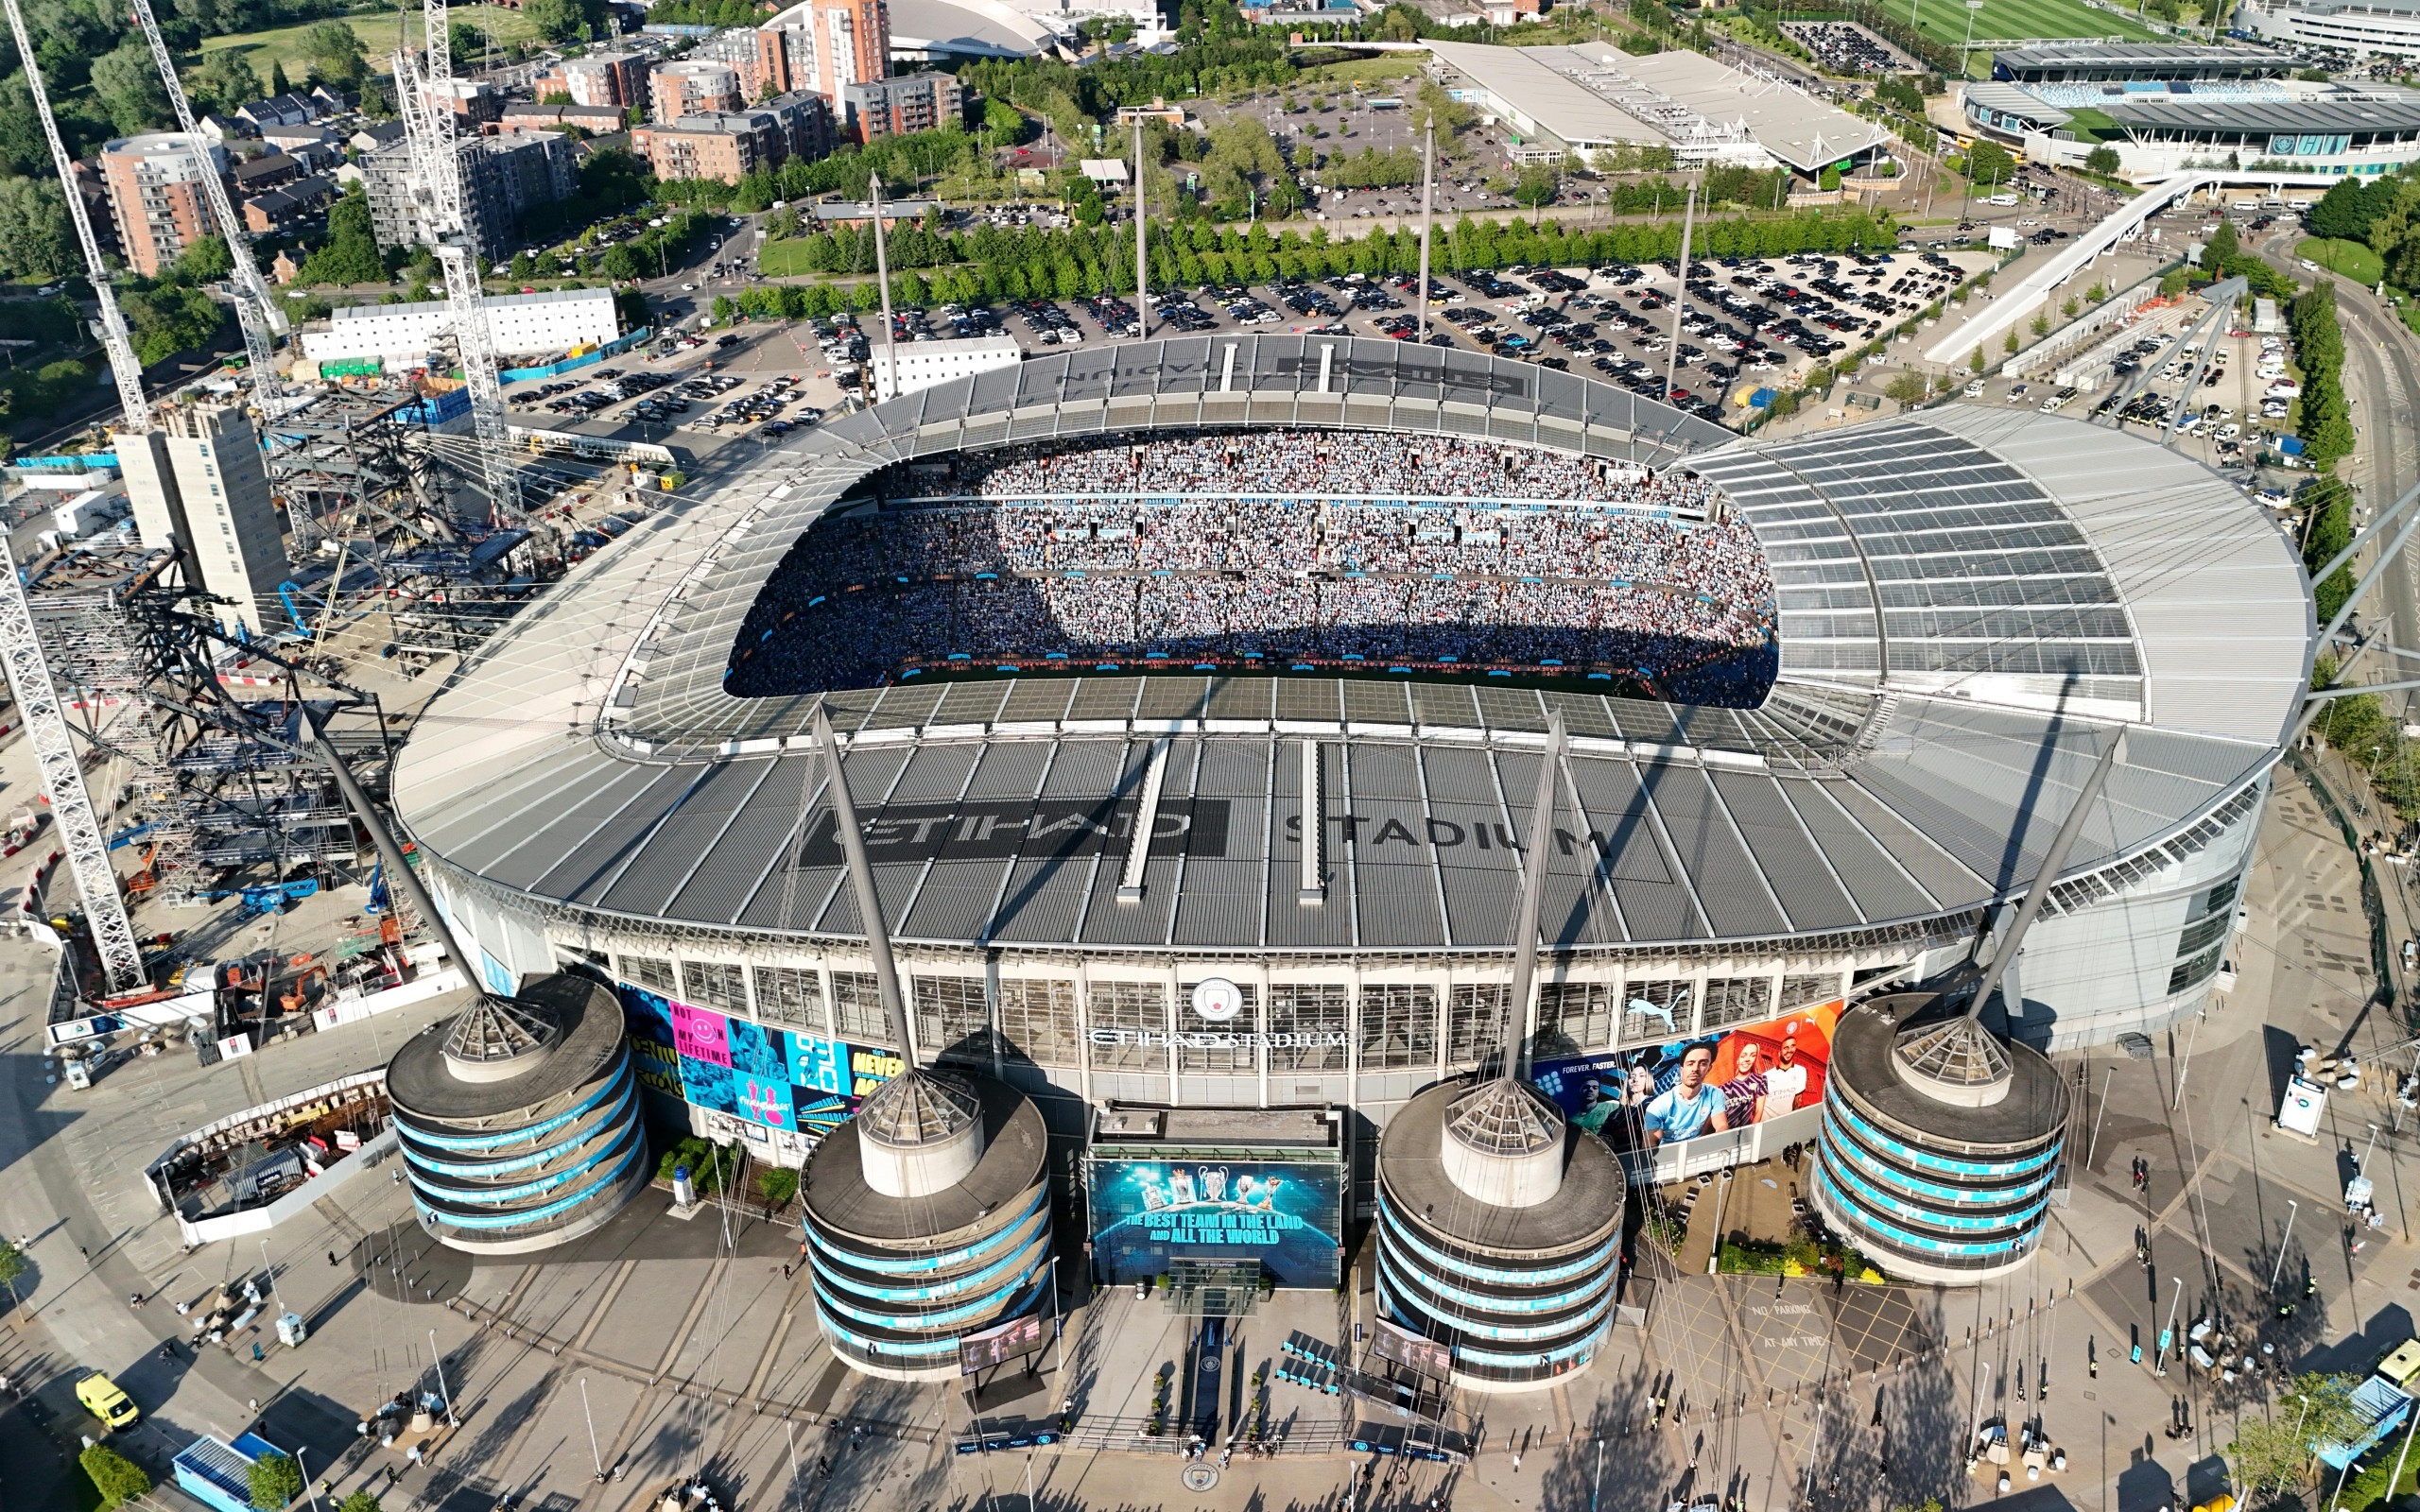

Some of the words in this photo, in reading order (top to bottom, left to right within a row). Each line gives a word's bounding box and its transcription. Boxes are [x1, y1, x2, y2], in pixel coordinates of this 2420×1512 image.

[2295, 135, 2350, 155] CITY
[673, 1005, 692, 1021] NOT
[678, 1029, 694, 1043] MY
[1088, 1028, 1228, 1049] ETIHAD
[1228, 1031, 1347, 1049] STADIUM
[678, 1040, 728, 1065] LIFETIME
[852, 1052, 906, 1078] NEVER
[1562, 1063, 1592, 1074] FOREVER.
[1592, 1060, 1617, 1072] FASTER.
[534, 1123, 553, 1134] love
[552, 1118, 562, 1126] of
[561, 1113, 573, 1123] my
[573, 1103, 588, 1115] own
[1860, 1155, 1888, 1176] CITY
[1989, 1163, 2017, 1175] CITY
[1895, 1202, 1926, 1219] CITY
[1126, 1214, 1144, 1226] THE
[1144, 1213, 1179, 1228] BEST
[1180, 1213, 1220, 1228] TEAM
[1221, 1214, 1236, 1228] IN
[1237, 1215, 1264, 1229] THE
[1267, 1215, 1304, 1230] LAND
[1150, 1230, 1169, 1241] AND
[1170, 1228, 1197, 1244] ALL
[1199, 1228, 1224, 1244] THE
[1226, 1229, 1280, 1245] WORLD
[1935, 1242, 1966, 1254] CITY
[1752, 1306, 1768, 1315] NO
[1773, 1304, 1811, 1315] PARKING
[1764, 1337, 1776, 1348] AT
[1781, 1336, 1798, 1348] ANY
[1800, 1336, 1825, 1347] TIME
[1185, 1463, 1216, 1474] MANCHESTER
